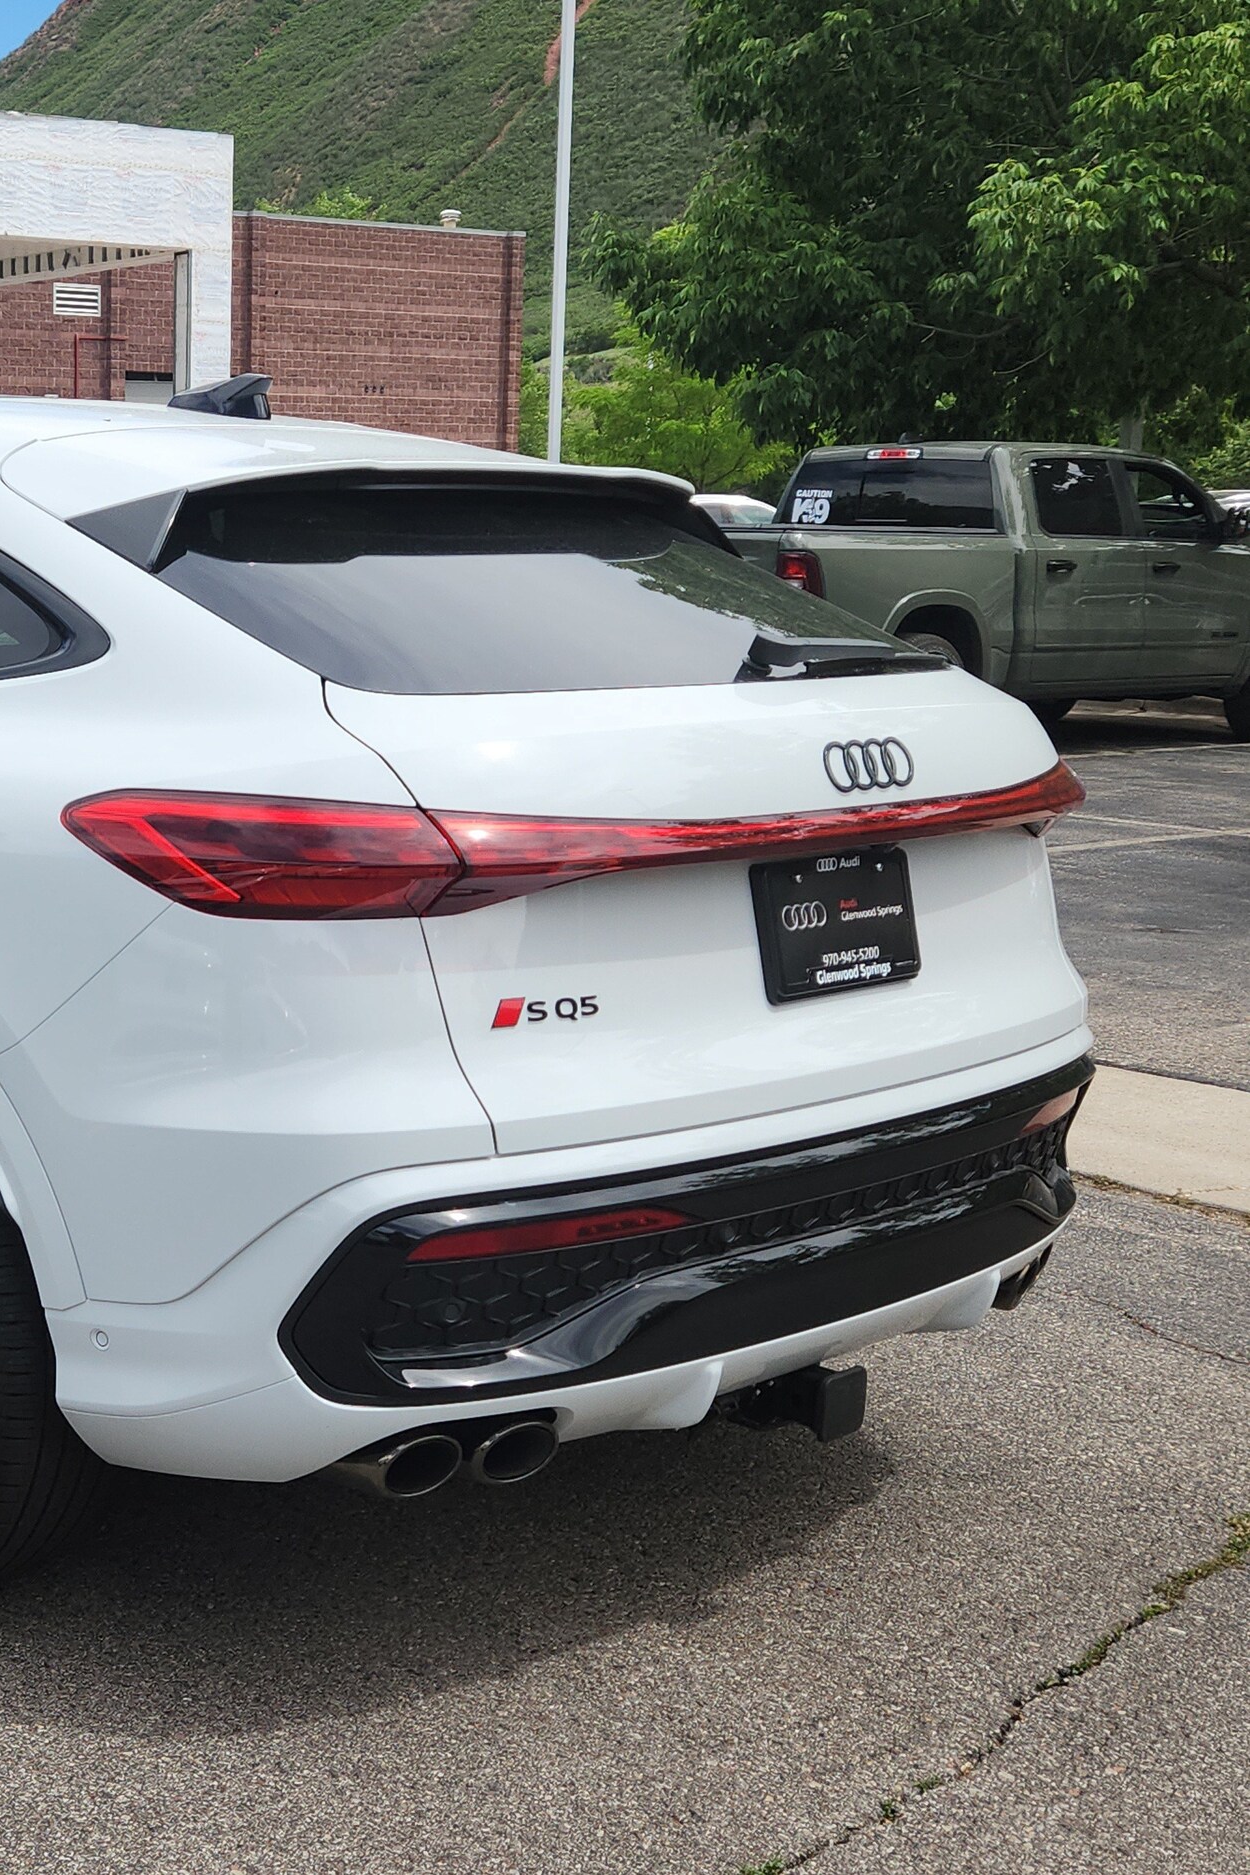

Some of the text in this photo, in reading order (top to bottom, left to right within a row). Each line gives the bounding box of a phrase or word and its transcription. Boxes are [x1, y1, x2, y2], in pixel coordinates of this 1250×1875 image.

[796, 489, 833, 498] CAUTION
[839, 855, 861, 869] Audi
[839, 899, 858, 909] Audi
[841, 903, 904, 921] Glenwood Springs
[822, 945, 881, 967] 970-945-5200
[816, 961, 892, 985] Glenwood Springs
